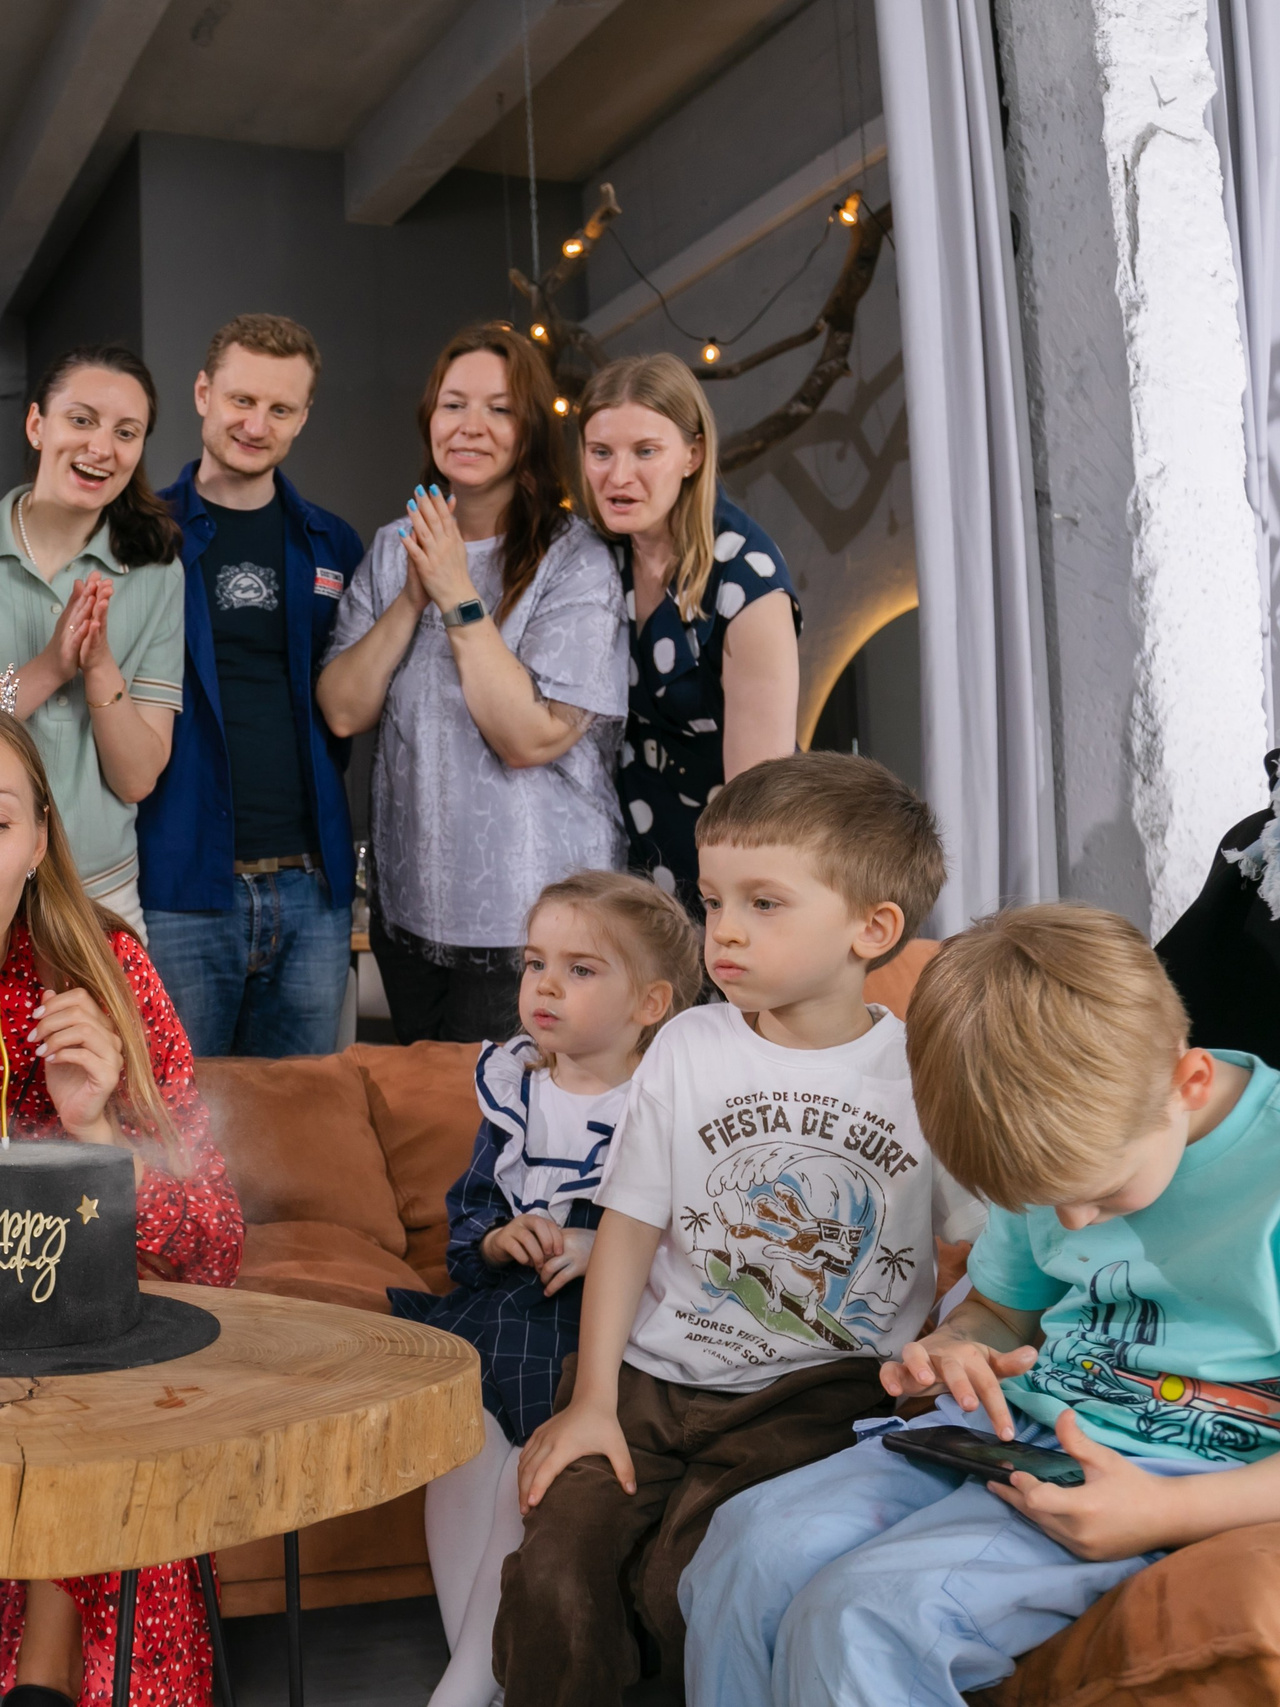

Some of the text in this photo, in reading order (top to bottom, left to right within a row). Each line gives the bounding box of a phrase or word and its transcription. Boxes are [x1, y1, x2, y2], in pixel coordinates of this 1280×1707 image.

[725, 1091, 896, 1135] COSTA DE LORET DE MAR
[801, 1106, 840, 1141] DE
[843, 1123, 919, 1179] SURF
[675, 1310, 735, 1334] MEJORES
